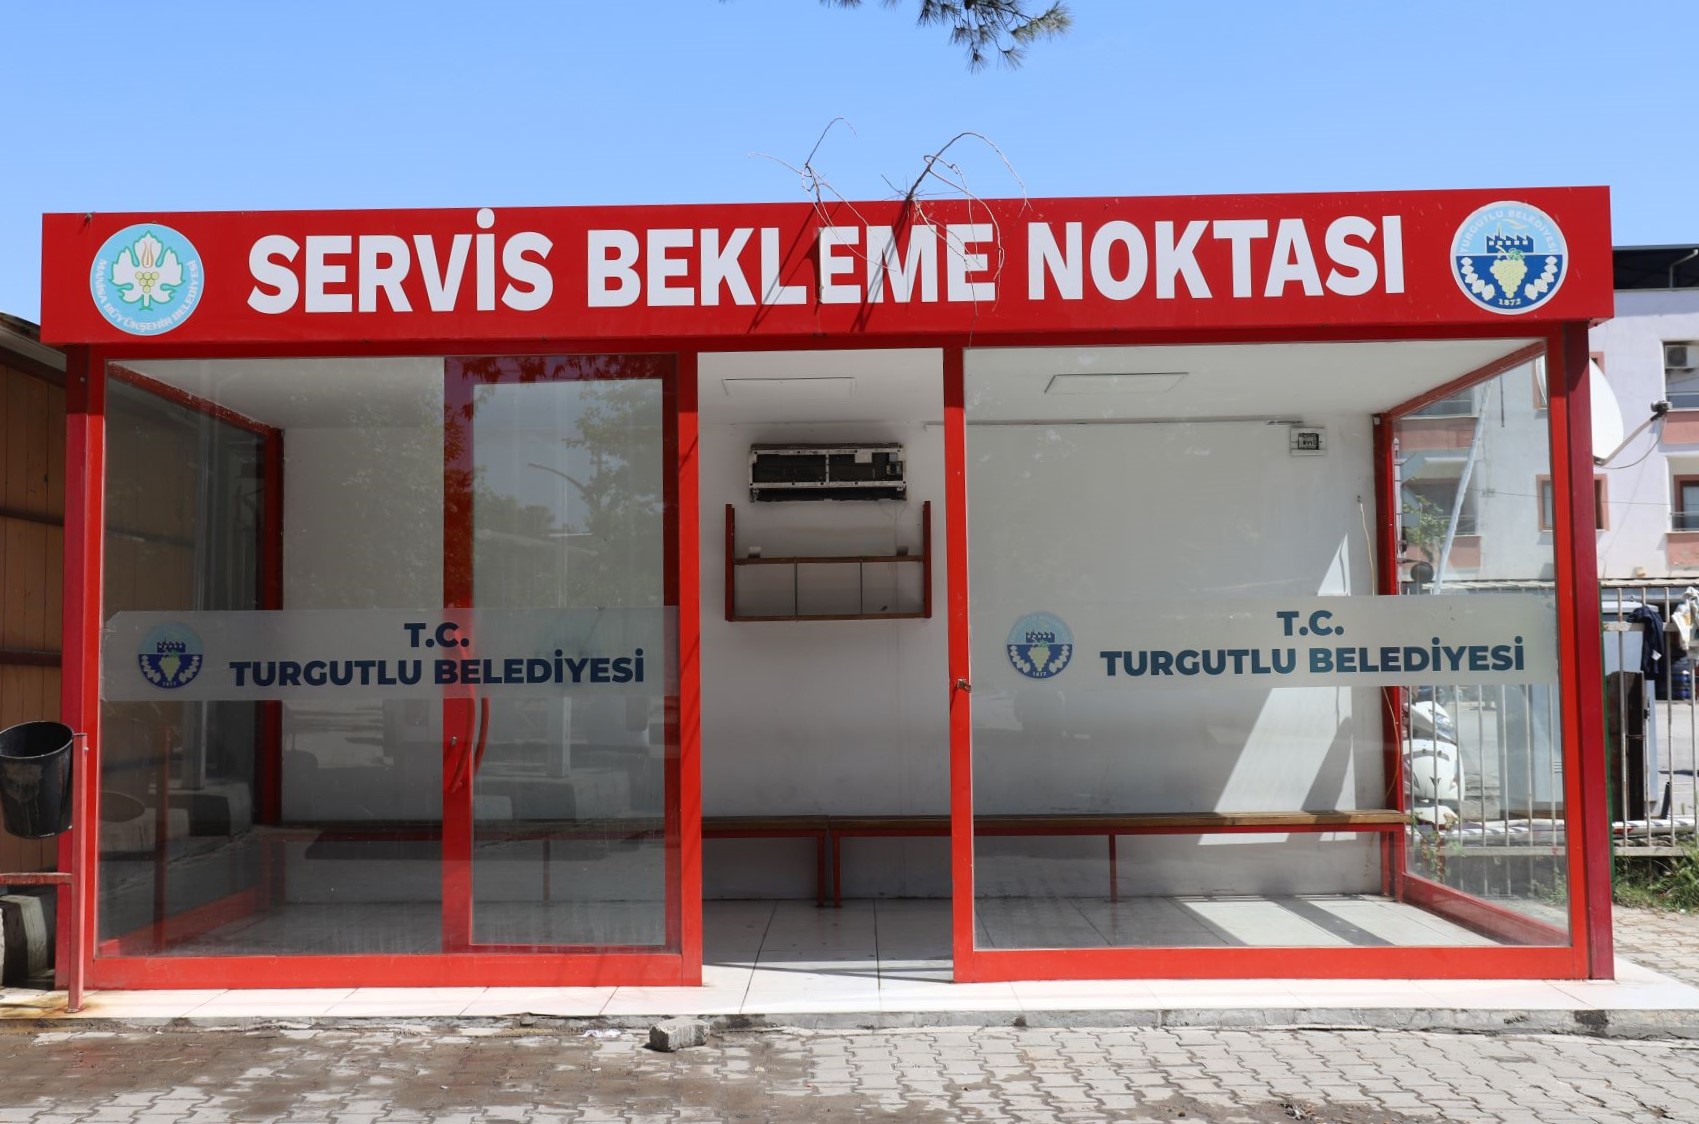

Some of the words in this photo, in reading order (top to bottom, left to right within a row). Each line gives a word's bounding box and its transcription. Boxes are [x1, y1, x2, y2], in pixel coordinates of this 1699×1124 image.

[1459, 210, 1504, 253] TURGUTLU
[247, 208, 554, 314] SERVİS
[587, 222, 996, 309] BEKLEME
[1027, 215, 1405, 301] NOKTASI
[1498, 298, 1521, 306] 1872
[404, 622, 470, 648] T.C.
[1276, 610, 1344, 637] T.C.
[229, 659, 422, 687] TURGUTLU
[434, 648, 644, 685] BELEDİYESİ
[1100, 648, 1296, 676] TURGUTLU
[1308, 635, 1525, 673] BELEDİYESİ
